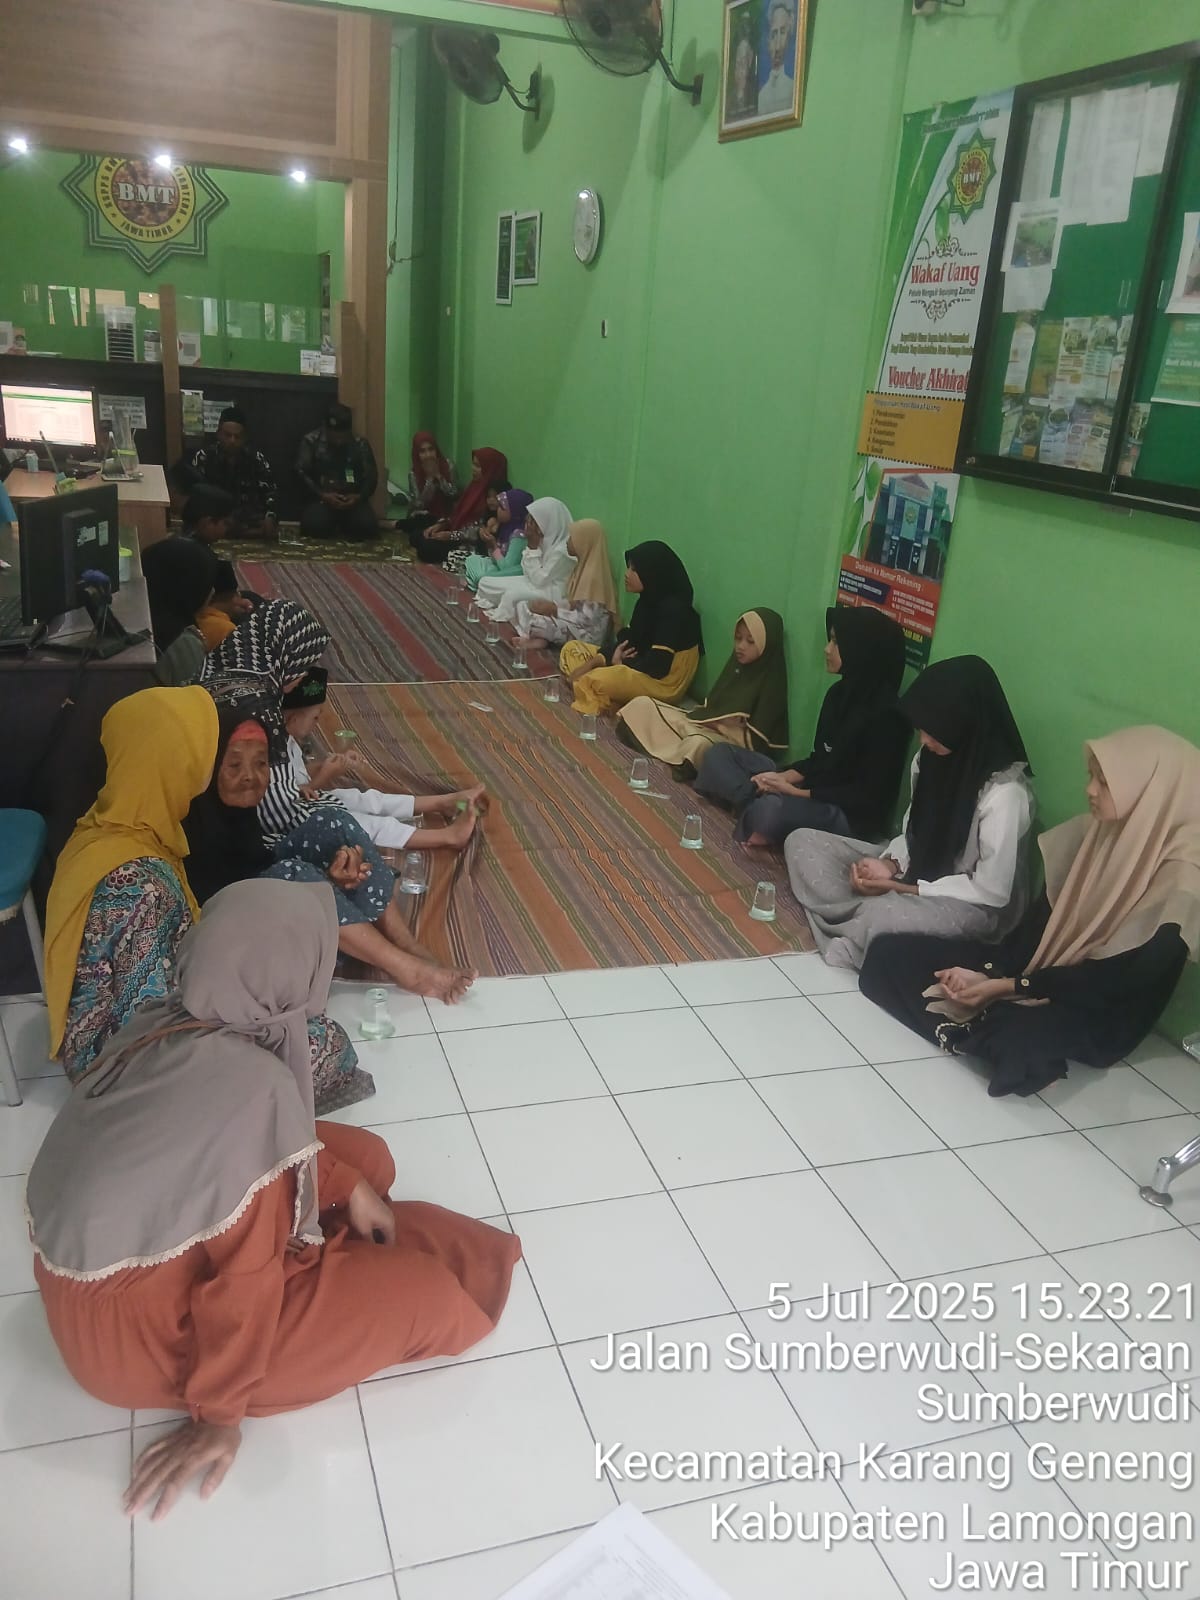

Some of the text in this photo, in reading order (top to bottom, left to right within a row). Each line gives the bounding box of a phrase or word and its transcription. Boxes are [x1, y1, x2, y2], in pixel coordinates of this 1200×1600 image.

[117, 182, 176, 205] BMT
[120, 221, 174, 238] JAWA TIMUR
[911, 262, 980, 286] Wakaf Uang
[889, 366, 927, 388] Voucher
